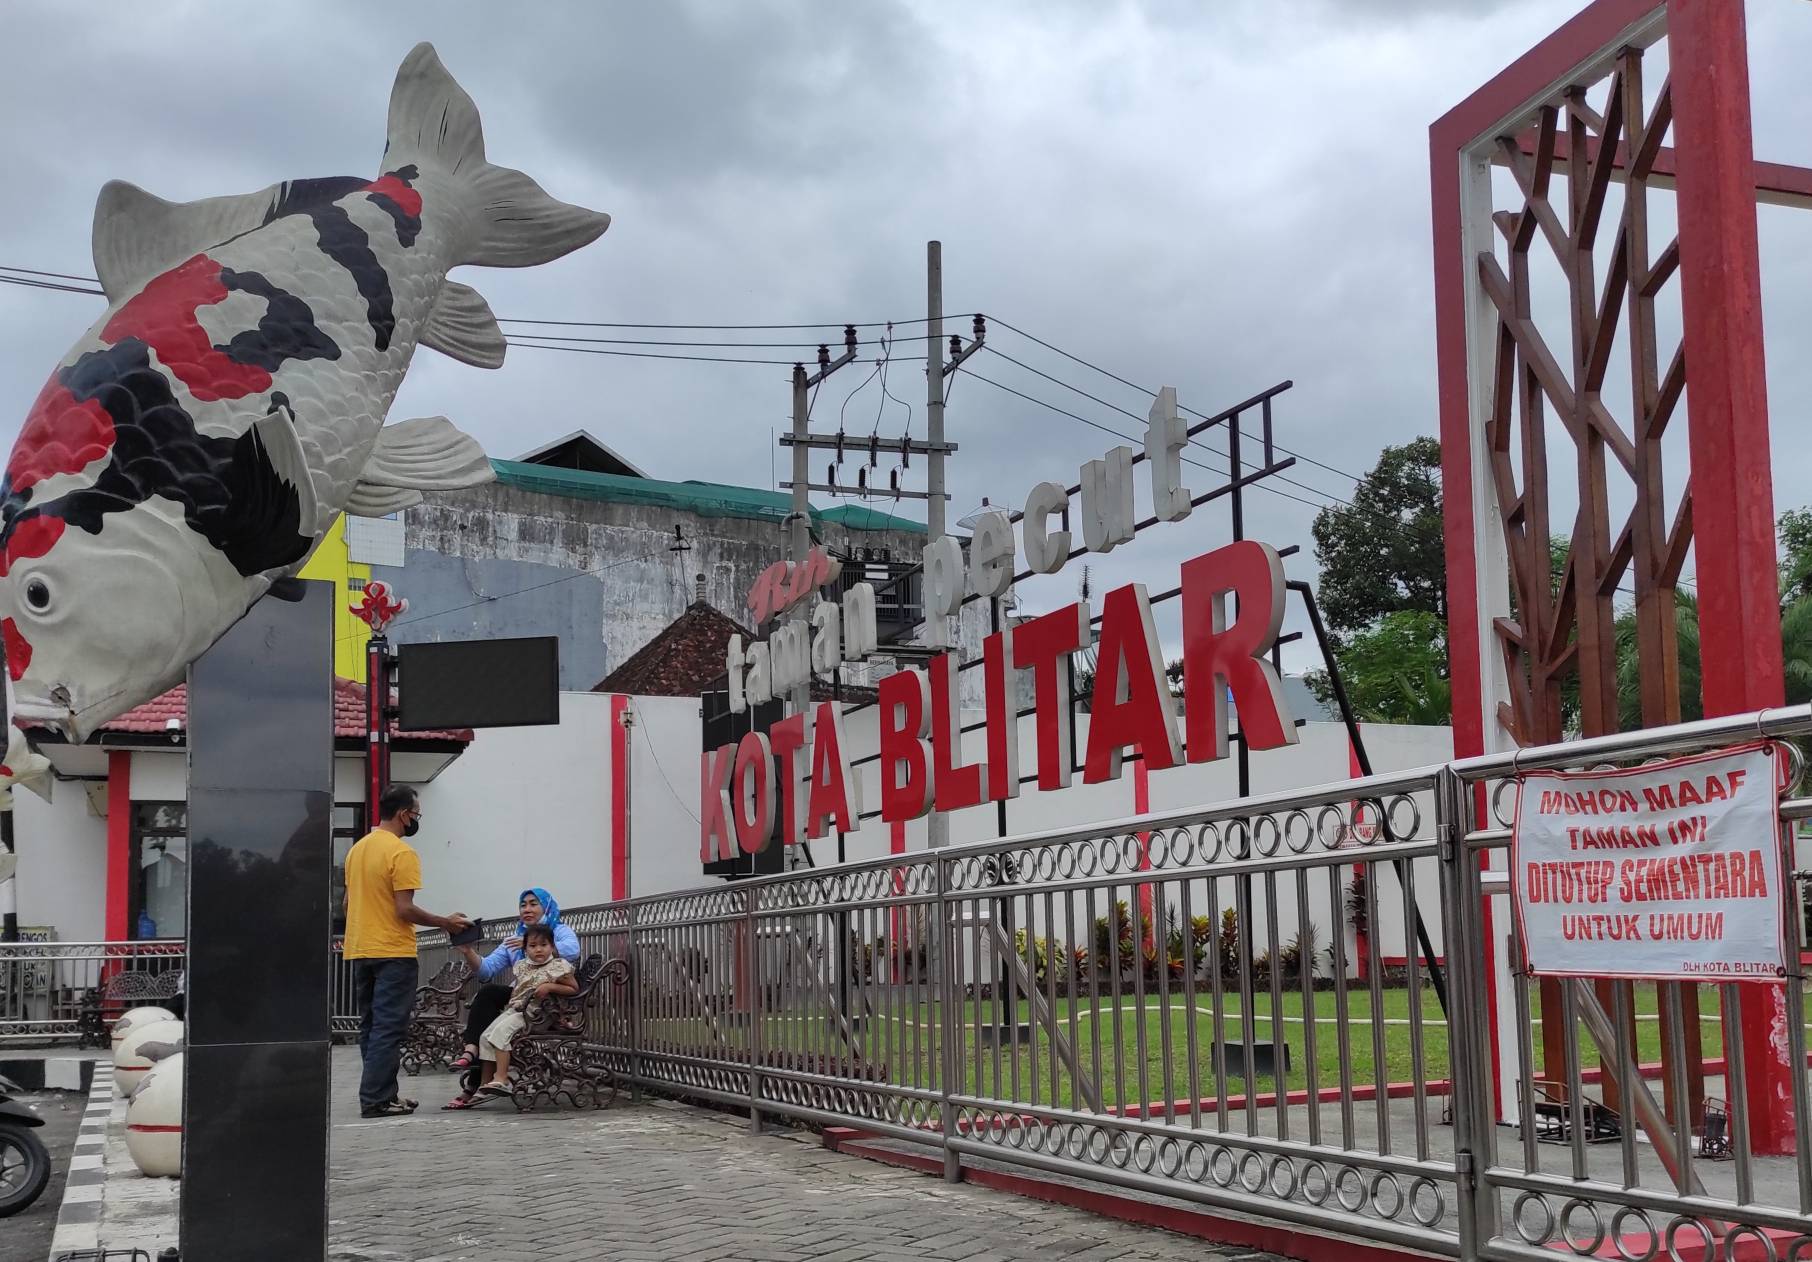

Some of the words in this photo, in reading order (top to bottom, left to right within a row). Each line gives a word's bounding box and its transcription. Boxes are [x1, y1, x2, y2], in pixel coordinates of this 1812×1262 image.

[726, 583, 877, 714] taman
[922, 386, 1192, 650] pecut
[701, 701, 860, 864] KOTA
[879, 540, 1300, 823] BLITAR
[1540, 787, 1639, 815] MOHON
[1642, 769, 1747, 813] MAAF
[1566, 822, 1660, 850] TAMAN
[1668, 815, 1707, 845] INI
[1527, 858, 1615, 904] DITUTUP
[1619, 849, 1769, 903] SEMENTARA
[1562, 913, 1641, 941] UNTUK
[1649, 911, 1724, 941] UMUM
[1703, 961, 1729, 973] KOTA
[1734, 961, 1777, 974] BLITAR
